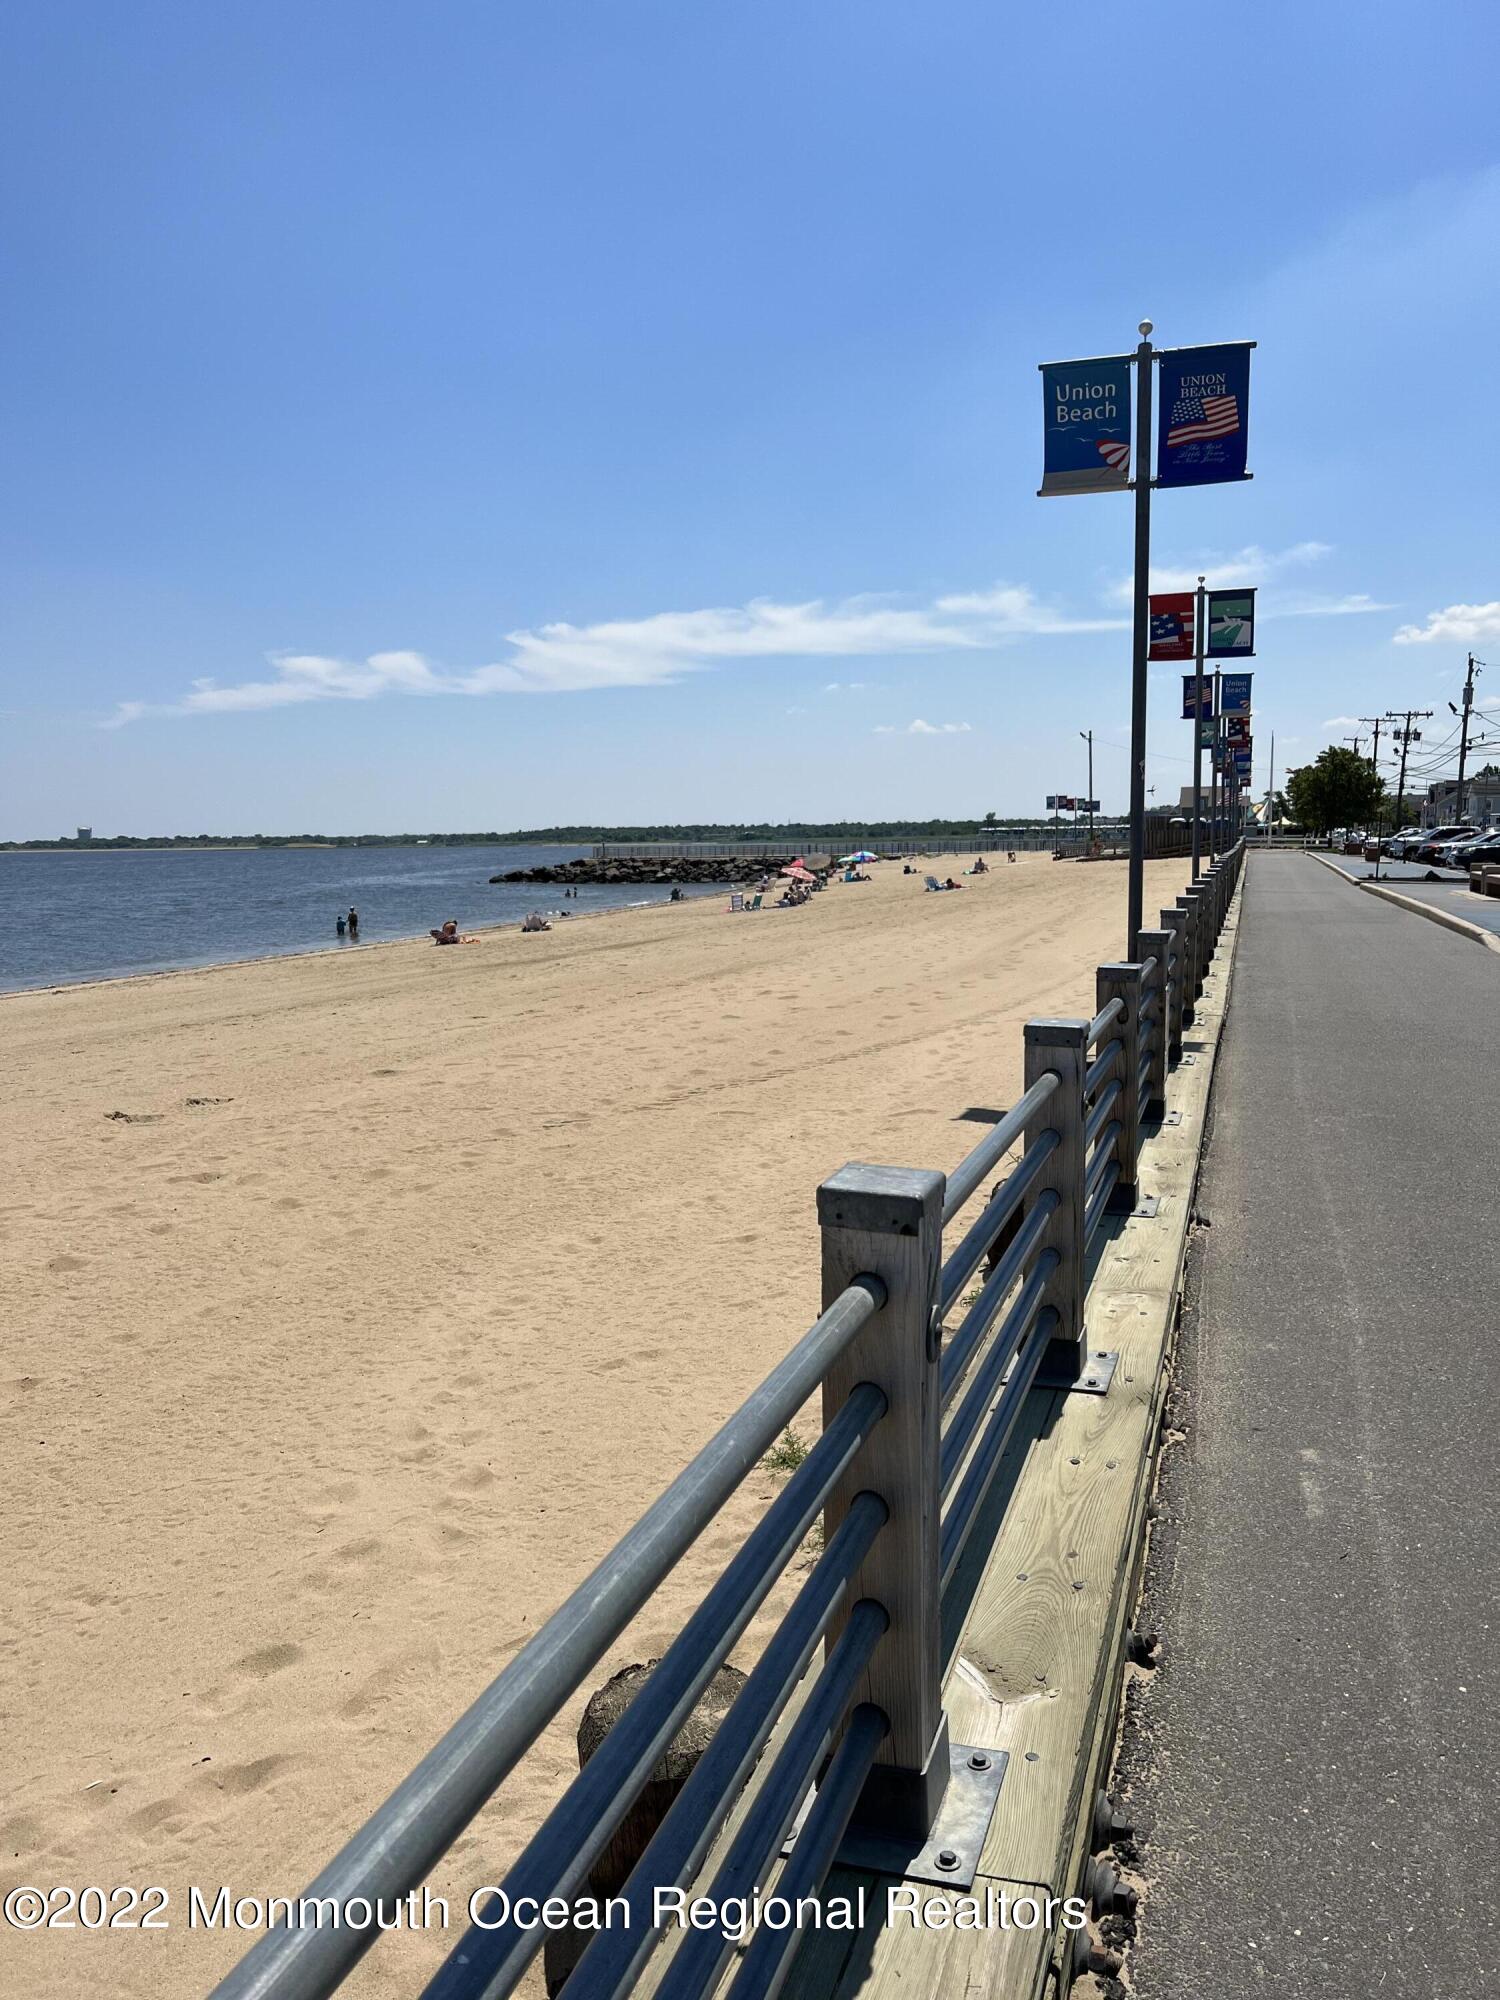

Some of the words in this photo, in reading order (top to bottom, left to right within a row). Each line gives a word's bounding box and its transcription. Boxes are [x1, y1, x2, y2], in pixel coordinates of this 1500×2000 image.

[1180, 373, 1226, 387] UNION
[1056, 382, 1116, 402] Union
[1180, 384, 1226, 398] BEACH
[1056, 401, 1117, 423] Beach
[1226, 686, 1247, 694] Beach
